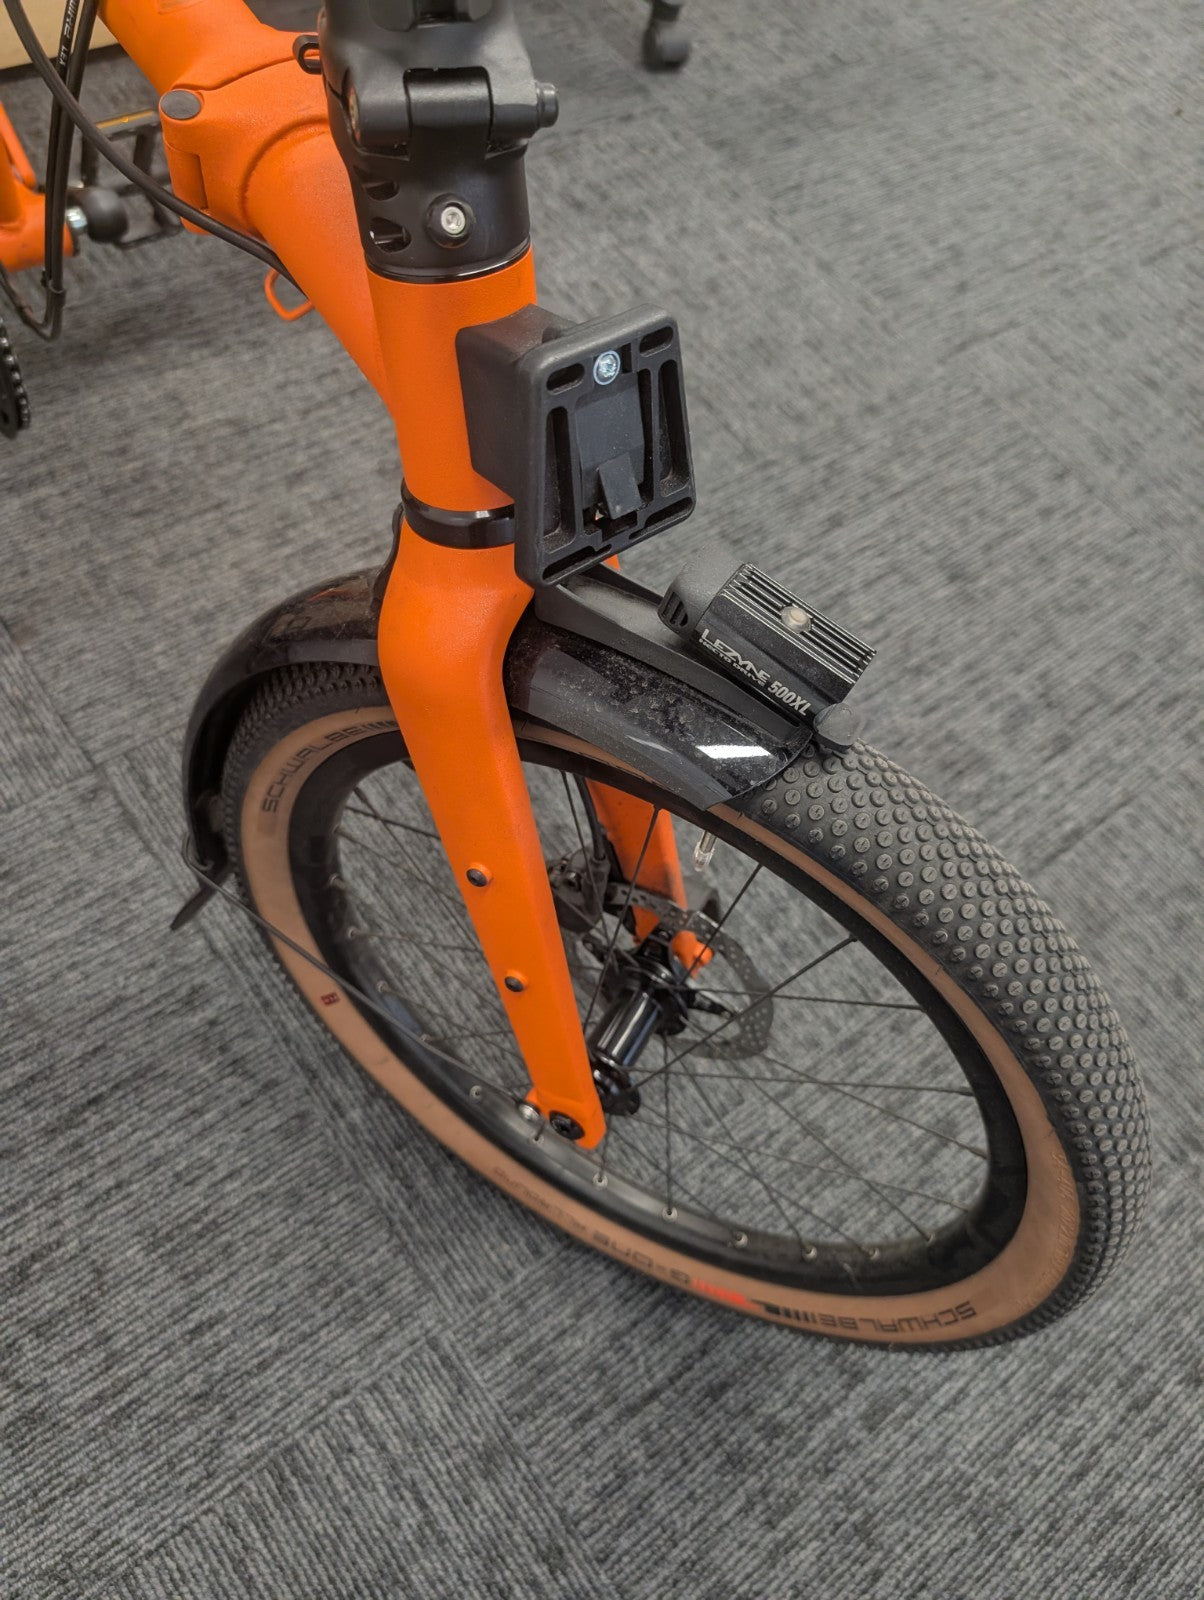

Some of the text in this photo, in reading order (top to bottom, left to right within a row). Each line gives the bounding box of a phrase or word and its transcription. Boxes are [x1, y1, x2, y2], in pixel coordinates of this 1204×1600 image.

[701, 628, 813, 716] LEZYNE 500XL
[261, 726, 365, 814] SCHWALBE
[820, 1300, 978, 1333] SCHWALBE
